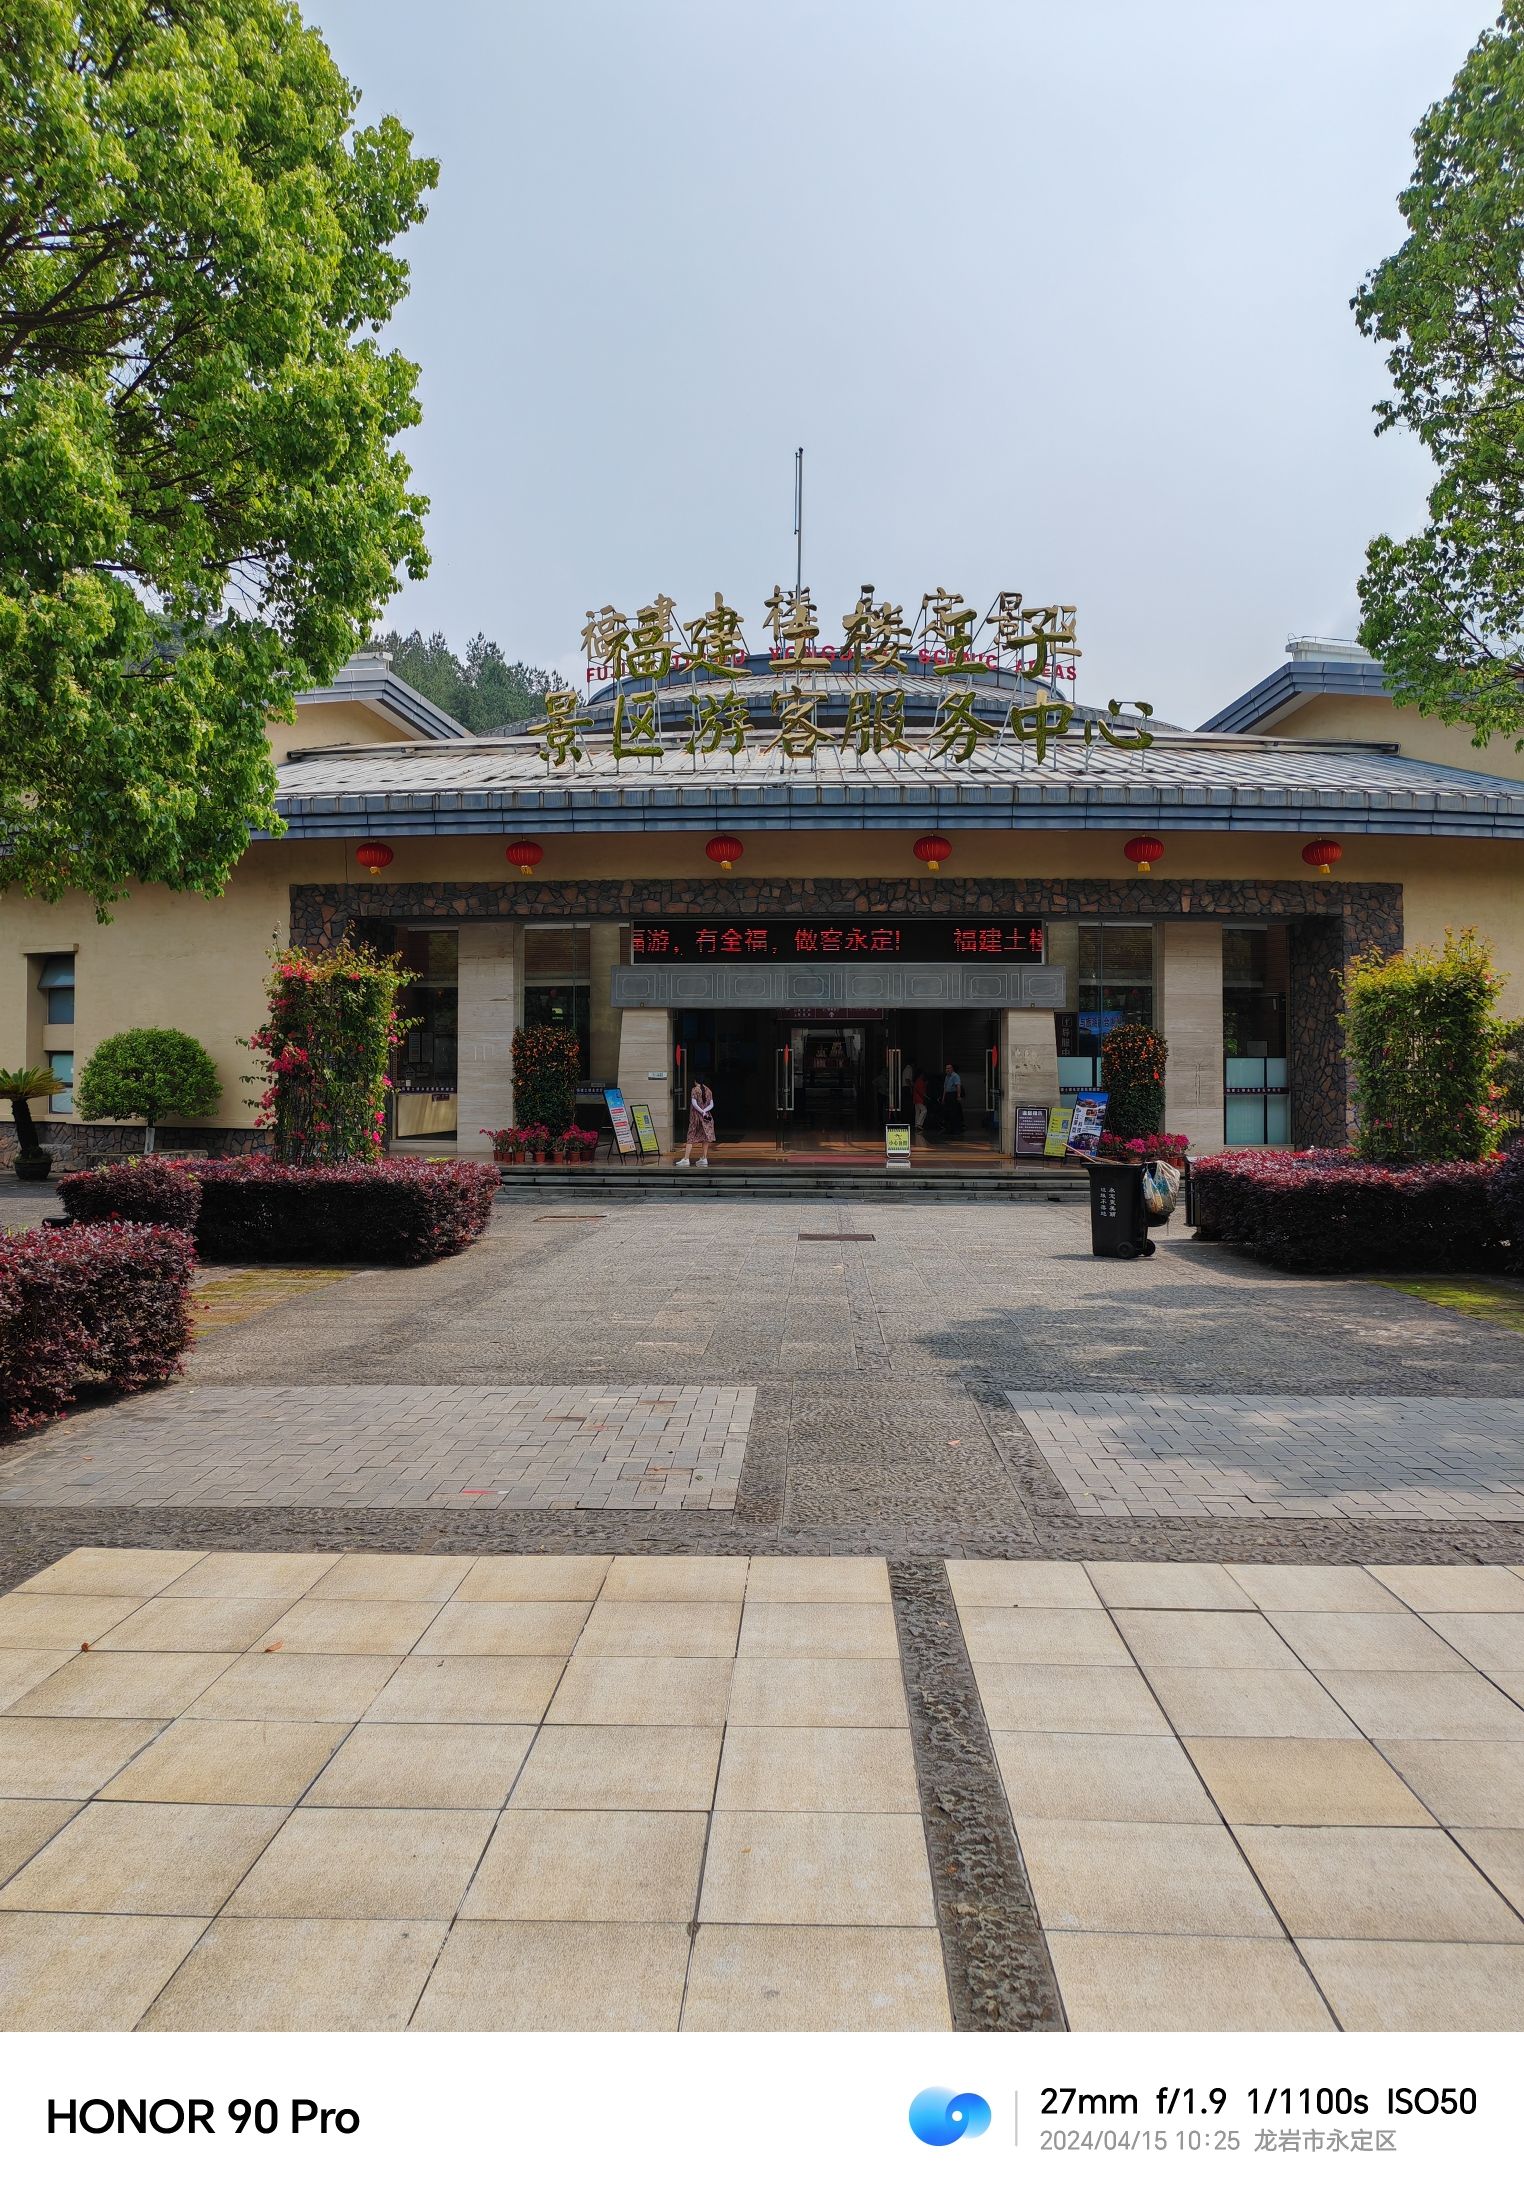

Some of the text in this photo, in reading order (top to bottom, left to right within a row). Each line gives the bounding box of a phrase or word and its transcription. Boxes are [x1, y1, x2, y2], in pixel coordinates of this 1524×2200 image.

[604, 600, 1072, 680] 福建土楼王子
[527, 684, 1155, 767] 景区游客服务中心
